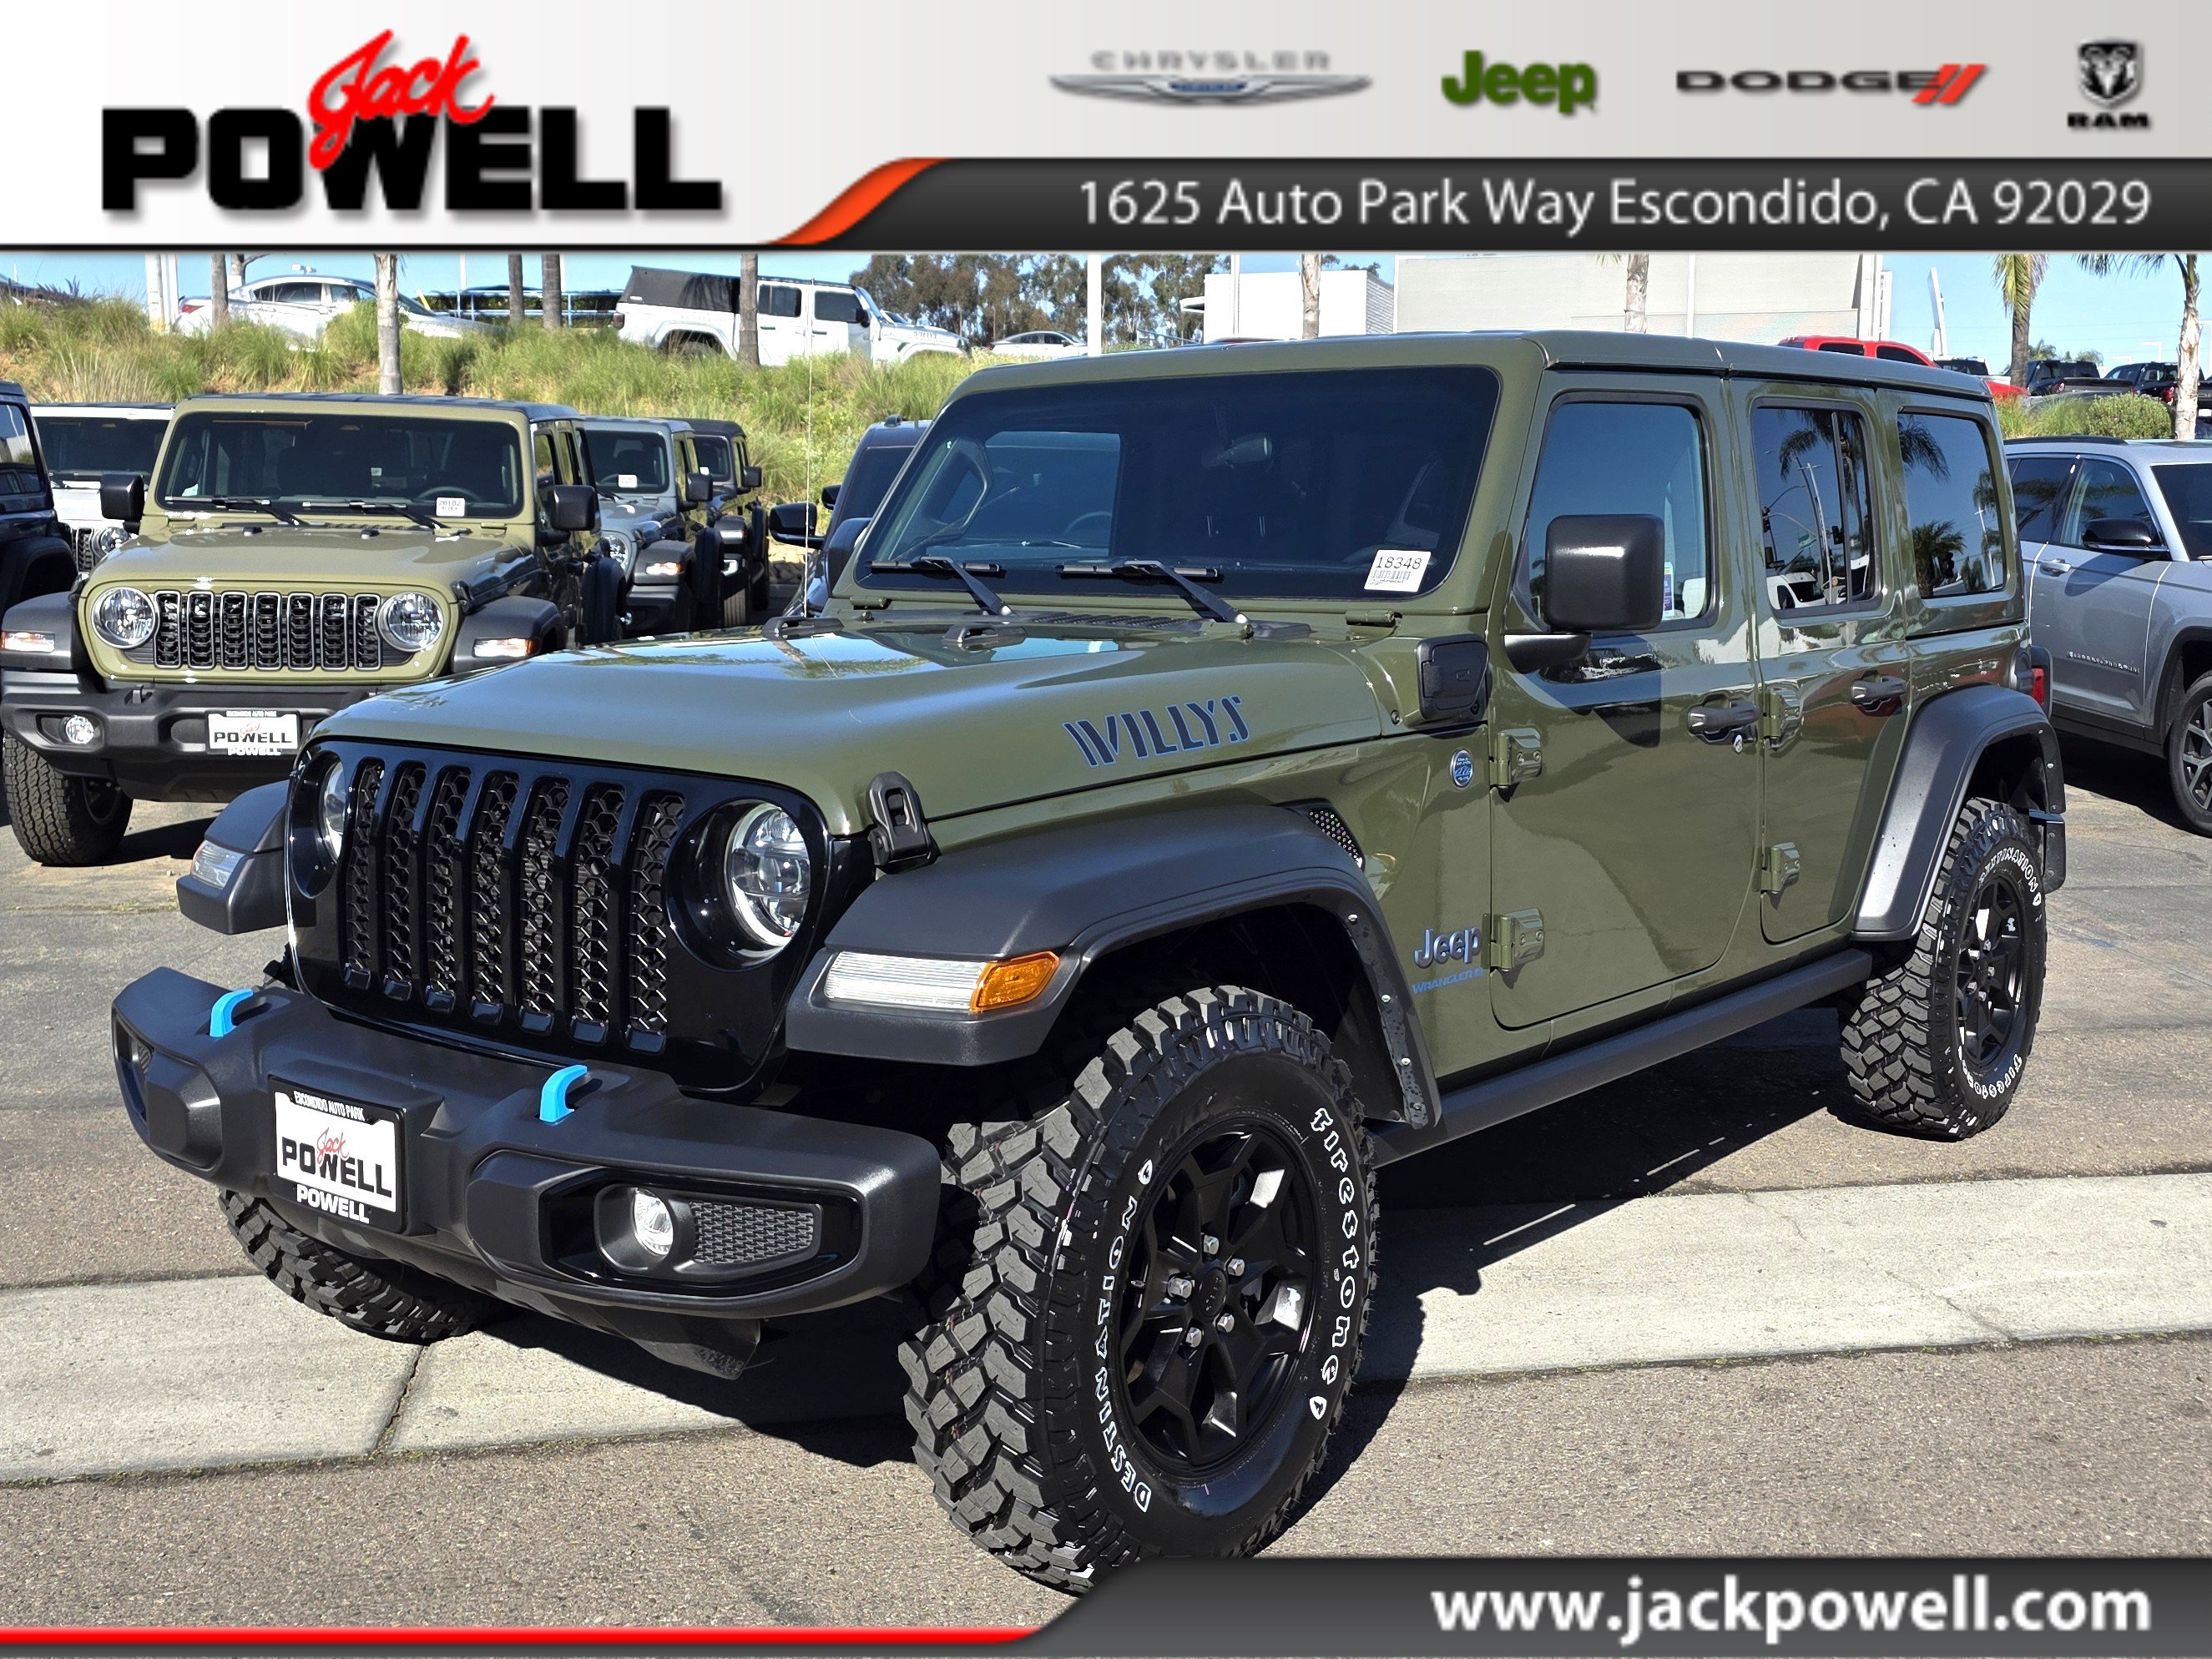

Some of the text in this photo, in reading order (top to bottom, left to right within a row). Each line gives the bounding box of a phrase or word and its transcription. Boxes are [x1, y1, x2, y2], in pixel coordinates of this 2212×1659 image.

[1376, 556, 1422, 570] 18348
[214, 732, 292, 744] POWELL
[1062, 694, 1250, 768] WILLYS
[1414, 927, 1482, 969] Jeep
[327, 1100, 346, 1117] AUTO
[345, 1104, 366, 1122] PARK
[316, 1127, 349, 1165] Jack
[281, 1136, 393, 1198] POWELL
[296, 1183, 370, 1224] POWELL
[1095, 1195, 1152, 1513] DESTINATION
